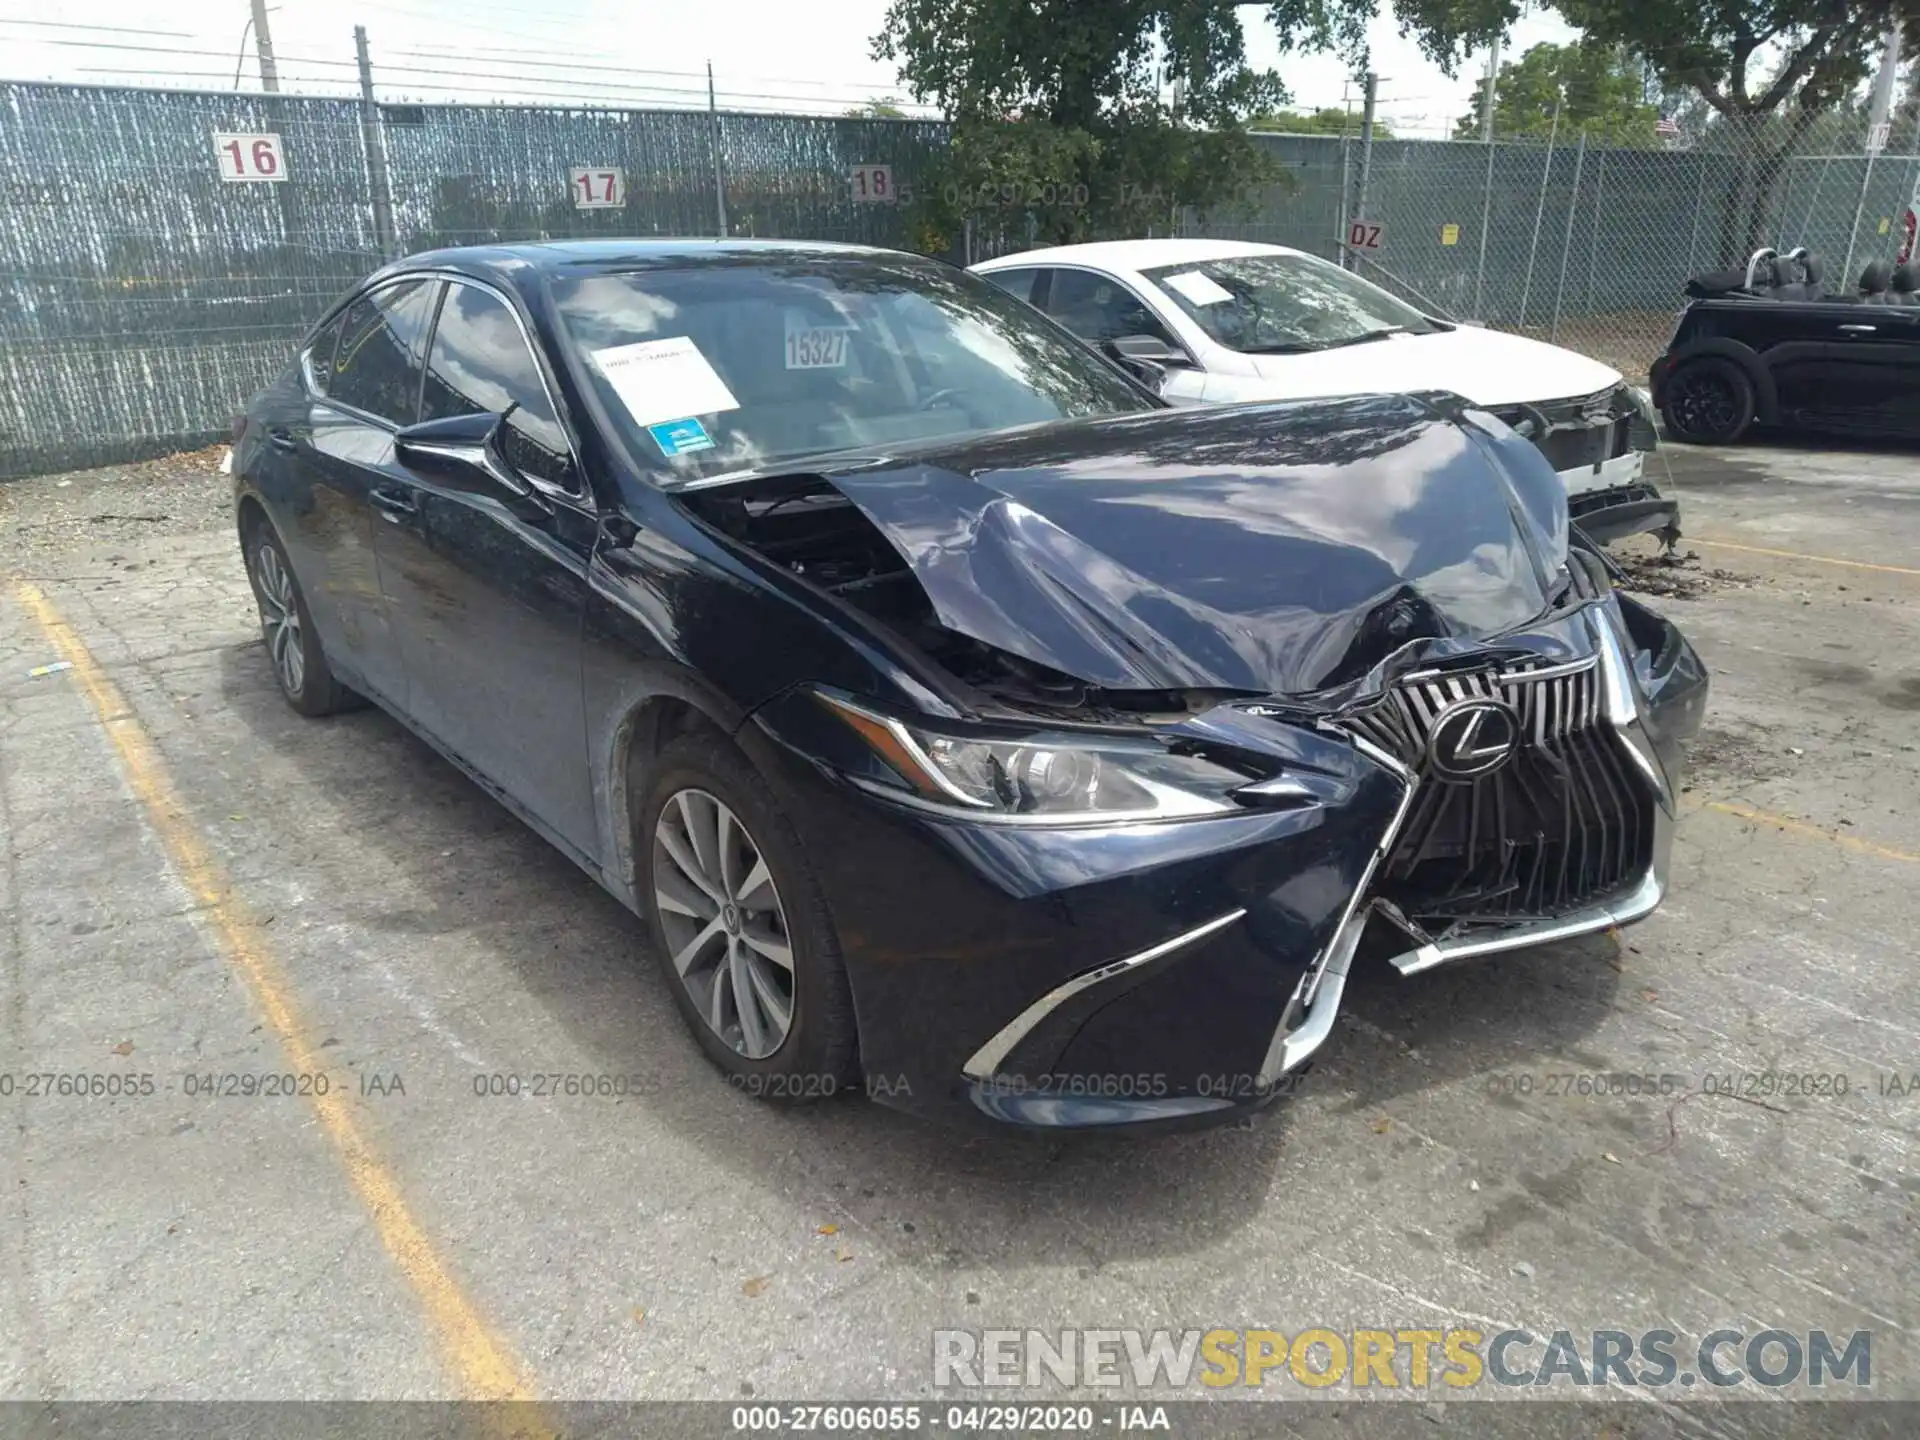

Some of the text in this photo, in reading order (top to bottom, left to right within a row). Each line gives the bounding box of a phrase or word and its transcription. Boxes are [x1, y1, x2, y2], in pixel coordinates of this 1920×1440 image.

[223, 140, 277, 174] 16
[577, 173, 615, 202] 17
[855, 170, 885, 195] 18
[1351, 224, 1381, 248] DZ
[788, 330, 844, 366] 15327
